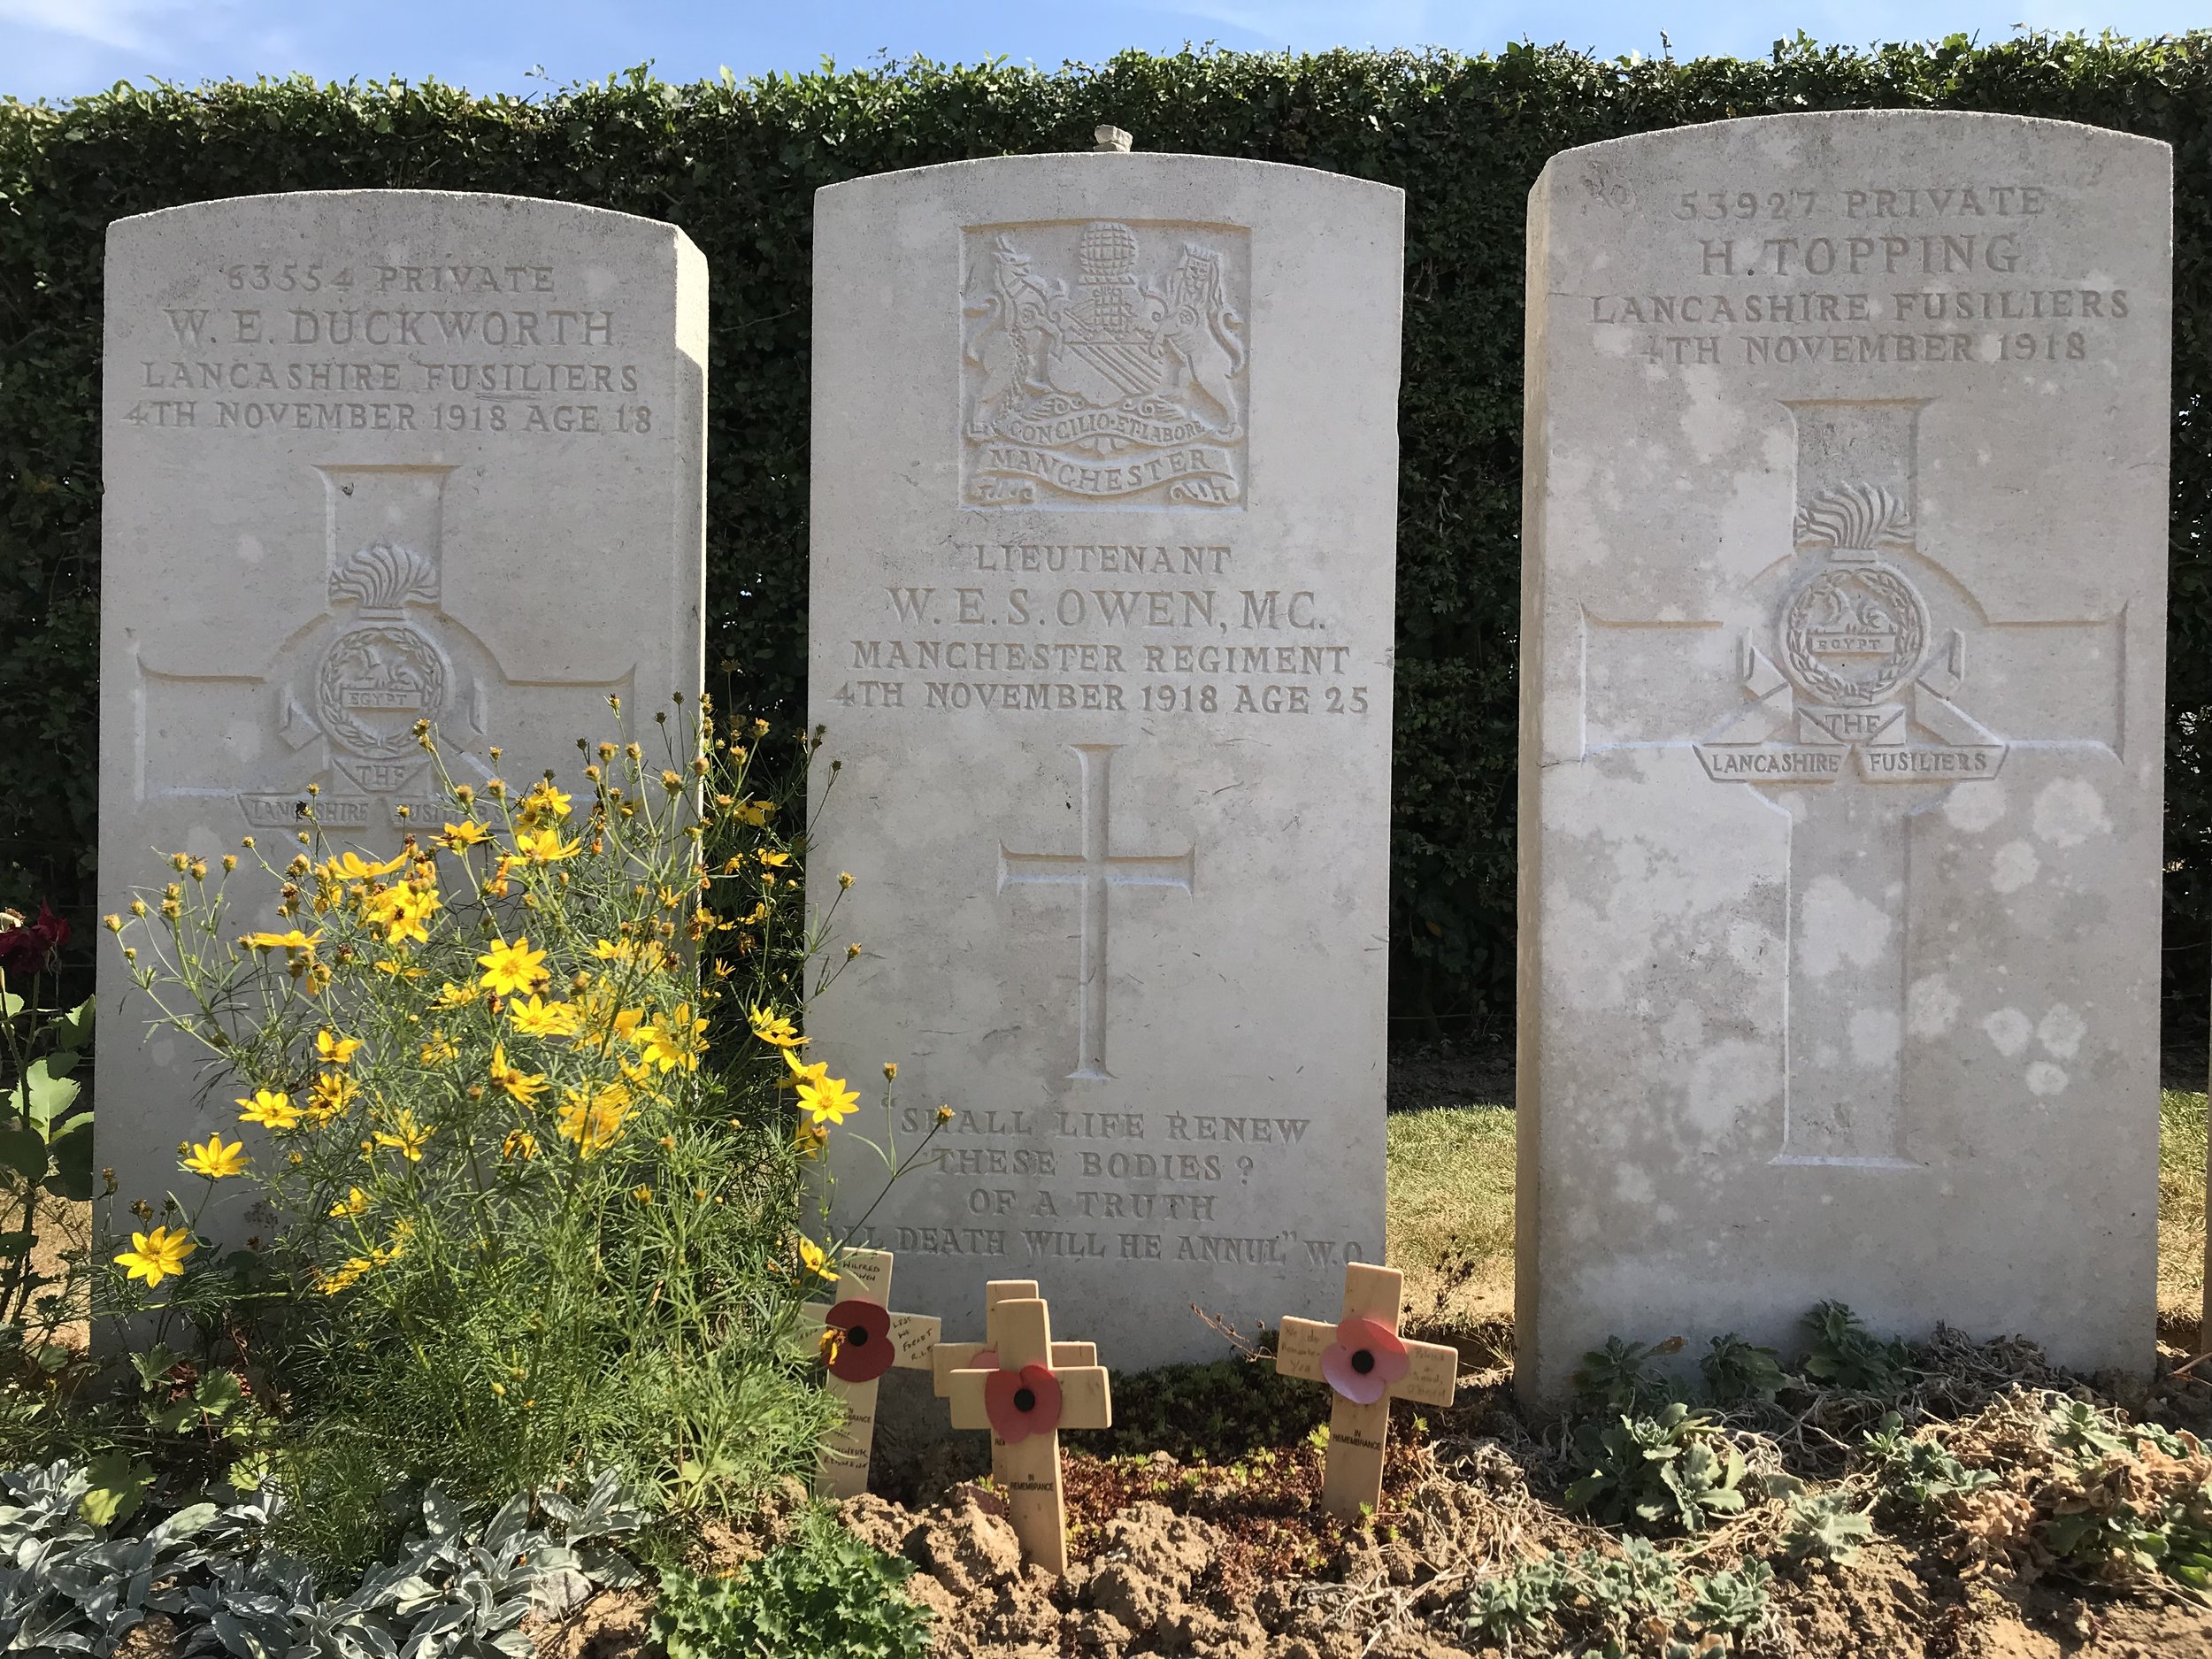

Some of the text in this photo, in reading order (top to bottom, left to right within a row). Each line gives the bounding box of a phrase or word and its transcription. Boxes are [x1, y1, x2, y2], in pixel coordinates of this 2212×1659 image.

[1671, 186, 2046, 220] 53927 PRIVATE
[227, 265, 557, 294] 63554 PRIVATE
[1591, 290, 2130, 326] LANCASHIRE FUSILIERS
[286, 310, 617, 348] DUCKWORTH
[1644, 331, 2086, 365] 4TH NOVEMBER 1918
[140, 361, 640, 394] LANCASHIRE FUSILIERS
[121, 400, 653, 434] 4TH NOVEMBER 1918 AGE 18
[989, 448, 1213, 492] MANCHESTER
[974, 545, 1232, 574] LIEUTENANT
[1240, 590, 1326, 632] MC.
[850, 640, 1350, 676] MANCHESTER REGIMENT
[1816, 637, 1881, 652] EGYPT
[348, 692, 409, 707] EGYPT
[828, 680, 1370, 715] 4TH NOVEMBER 1918 AGE 25
[1825, 713, 1881, 734] THE
[1713, 752, 1987, 773] LANCASHIRE FUSILIERS
[1055, 1110, 1145, 1141] LIFE
[1164, 1114, 1310, 1145] RENEW
[931, 1148, 1056, 1177] THESE
[1077, 1151, 1222, 1182] BODIES
[968, 1187, 1217, 1222] OF A TRUTH
[895, 1226, 1006, 1257] DEATH
[1020, 1230, 1105, 1259] WILL
[1117, 1233, 1162, 1261] HE
[842, 1260, 880, 1272] WILFRED
[892, 1316, 911, 1328] LEST
[1333, 1432, 1382, 1451] REMEMBRANCE
[1353, 1429, 1362, 1438] IN
[1010, 1481, 1055, 1493] REMEMBRANCE
[1027, 1473, 1034, 1482] IN
